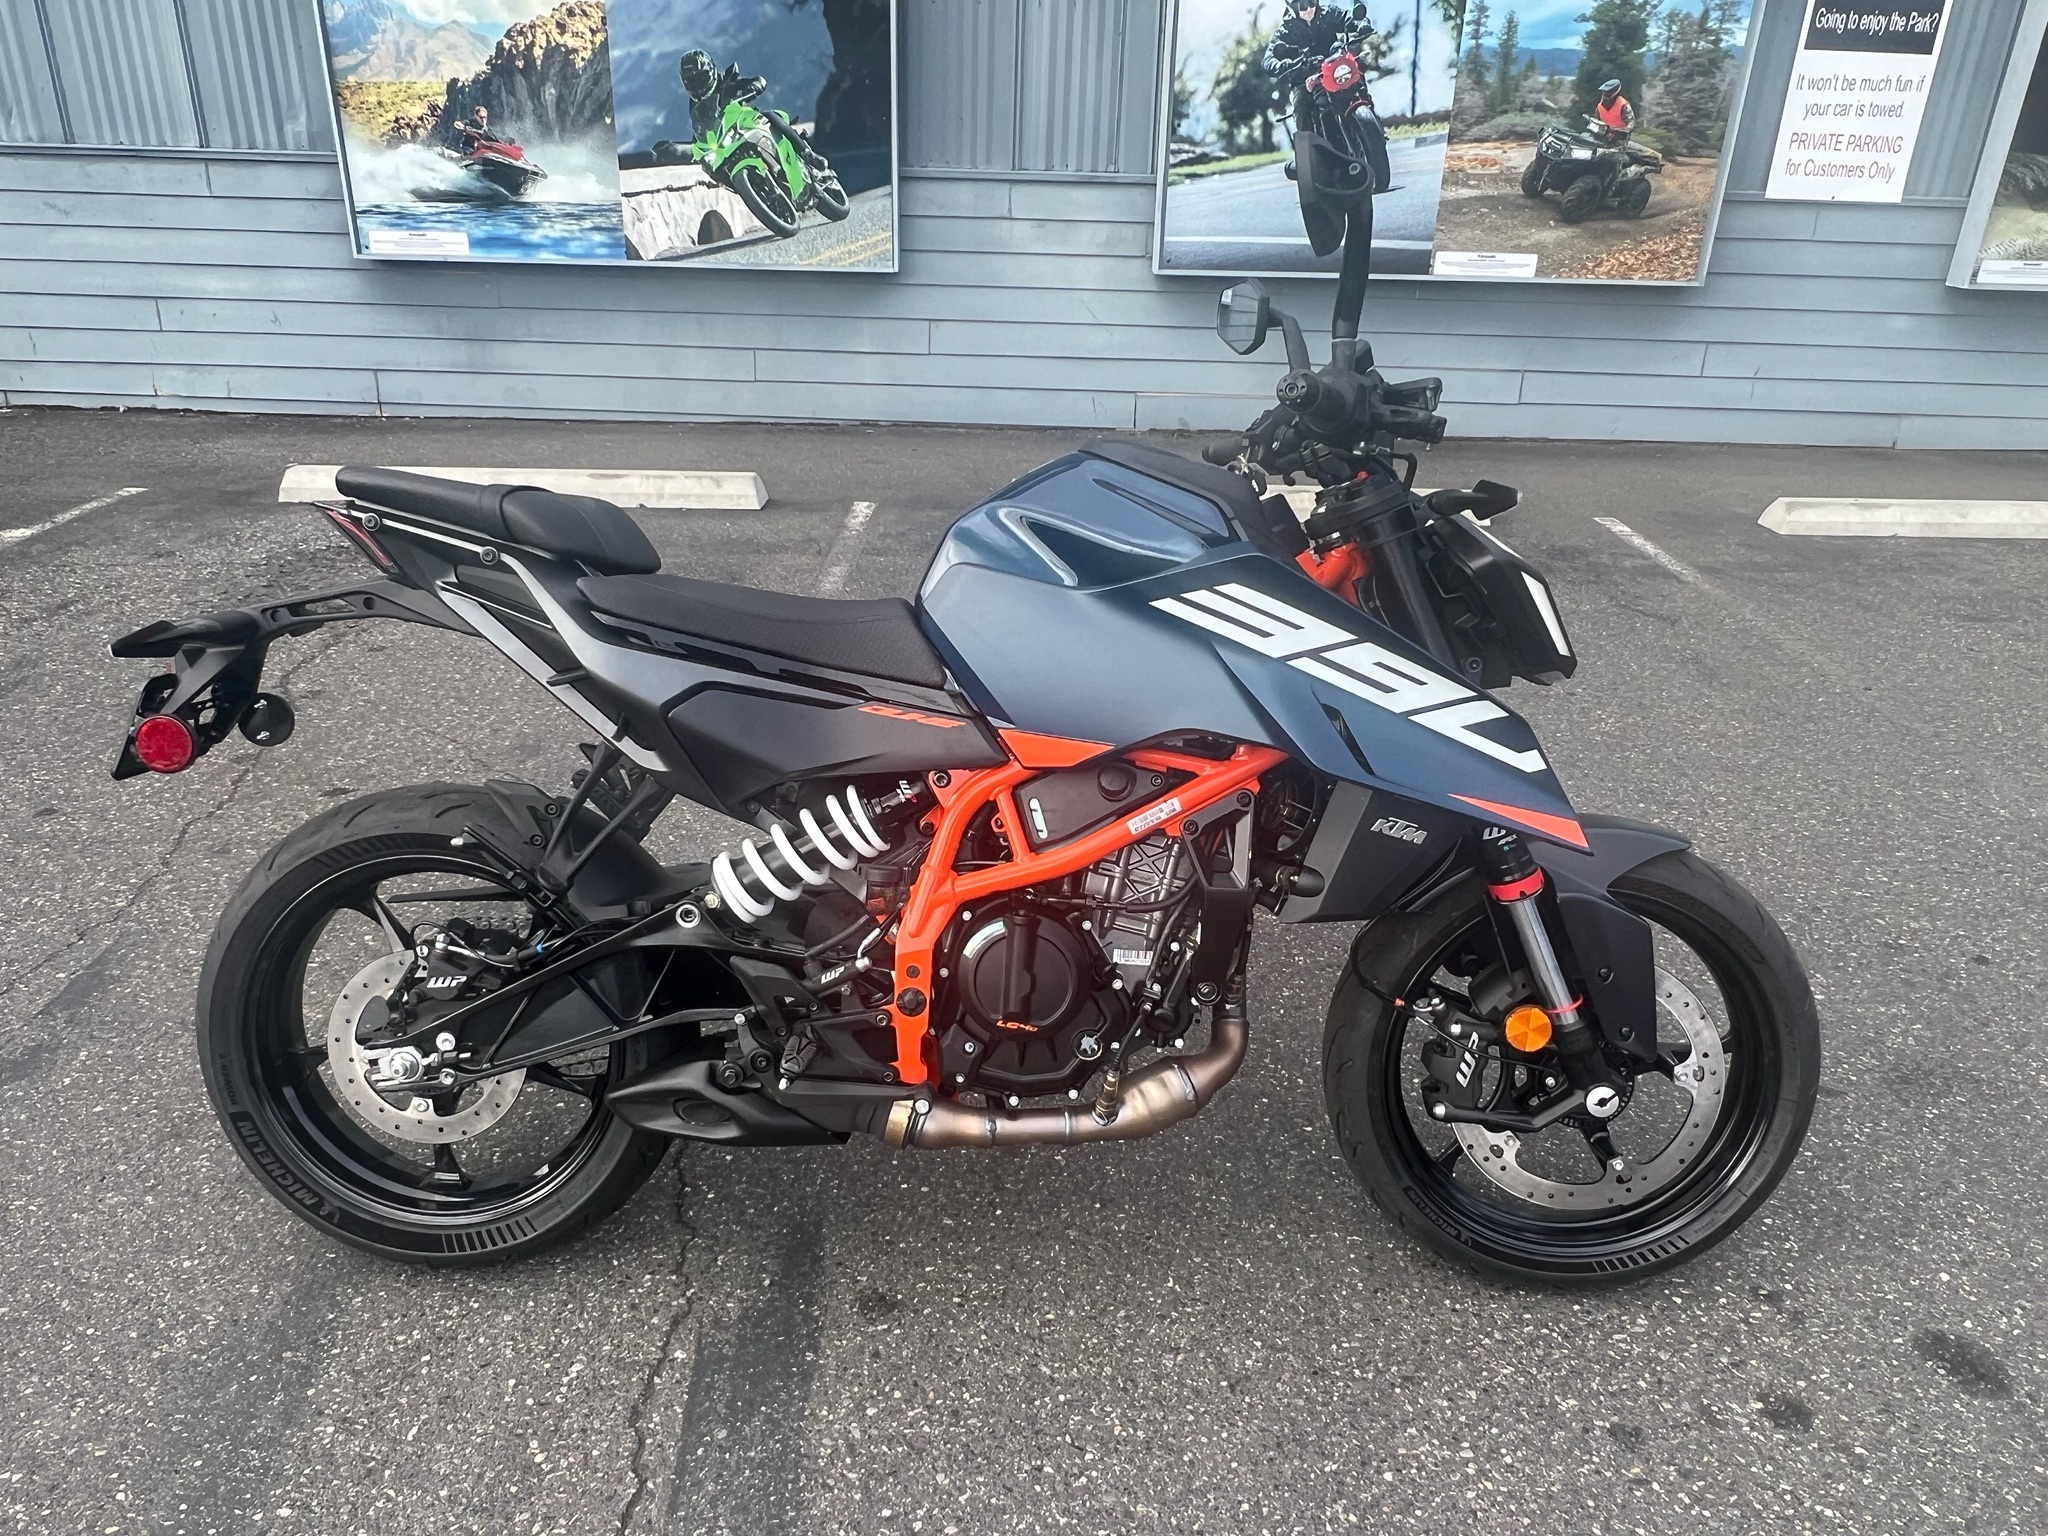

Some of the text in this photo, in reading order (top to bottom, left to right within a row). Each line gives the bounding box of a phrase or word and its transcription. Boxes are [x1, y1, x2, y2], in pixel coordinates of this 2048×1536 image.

[1815, 7, 1940, 36] Going to enjoy the Park?
[1796, 73, 1927, 92] It won't be much fun if
[1803, 100, 1905, 120] your car is towed.
[1789, 132, 1904, 153] PRIVATE PARKING
[1785, 158, 1896, 184] for Customers Only
[1370, 817, 1428, 845] KTM
[426, 975, 468, 989] WP
[237, 1120, 320, 1206] MICHELIN
